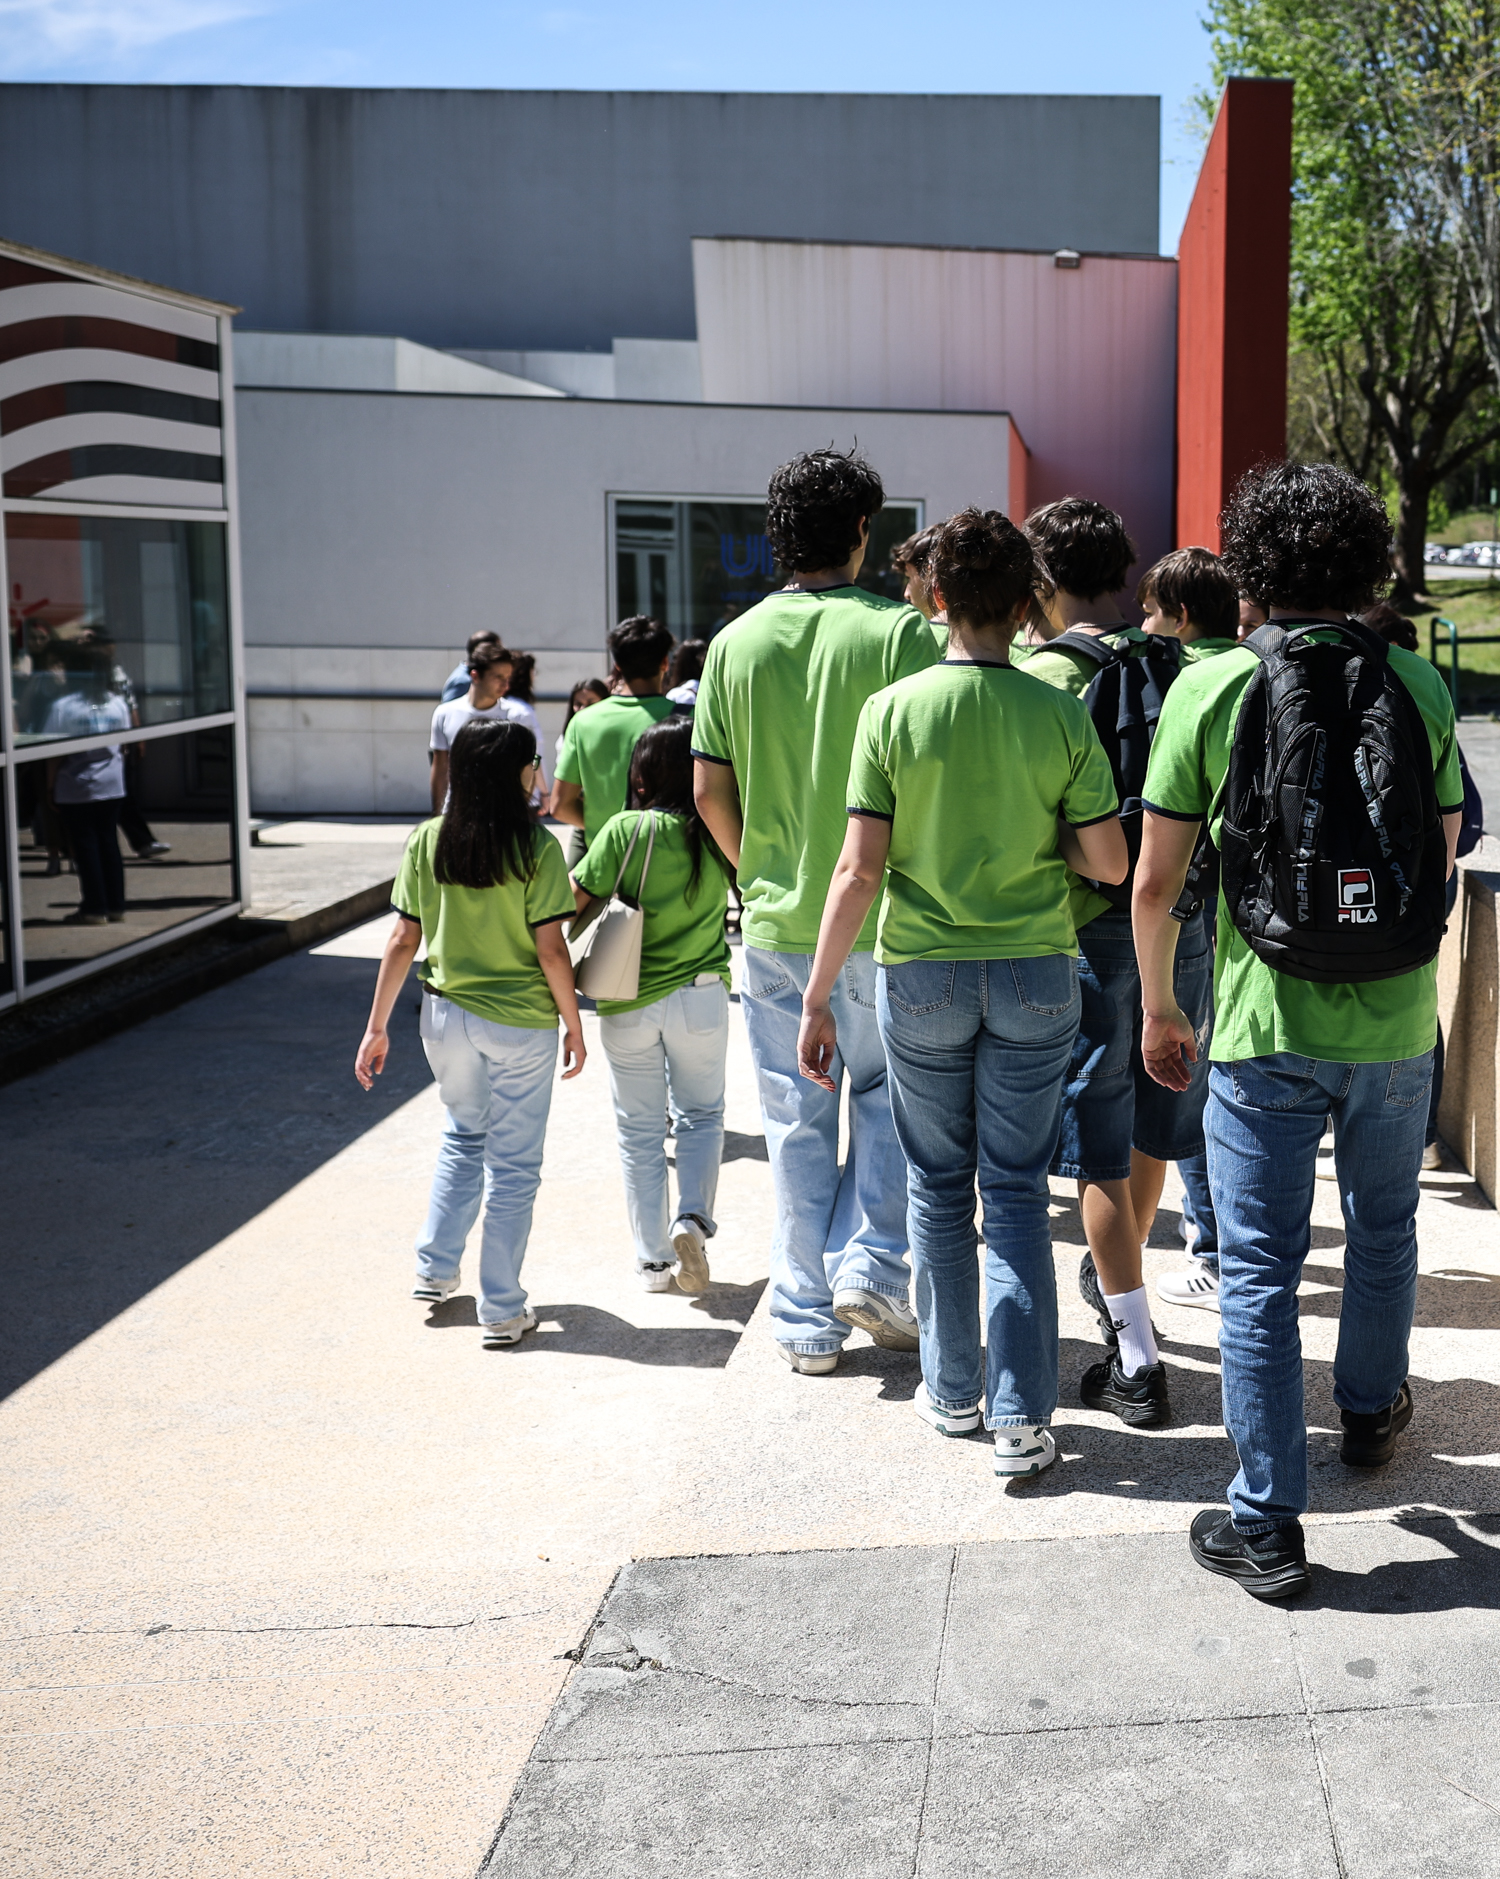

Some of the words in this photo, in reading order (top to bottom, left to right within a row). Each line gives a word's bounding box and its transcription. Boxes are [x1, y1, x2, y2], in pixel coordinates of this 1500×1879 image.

[1312, 760, 1325, 790] FILA
[1358, 770, 1373, 802] FILA
[1299, 828, 1313, 860] FILA
[1375, 826, 1392, 859] FILA
[1297, 890, 1310, 922] FILA
[1338, 908, 1378, 924] FILA
